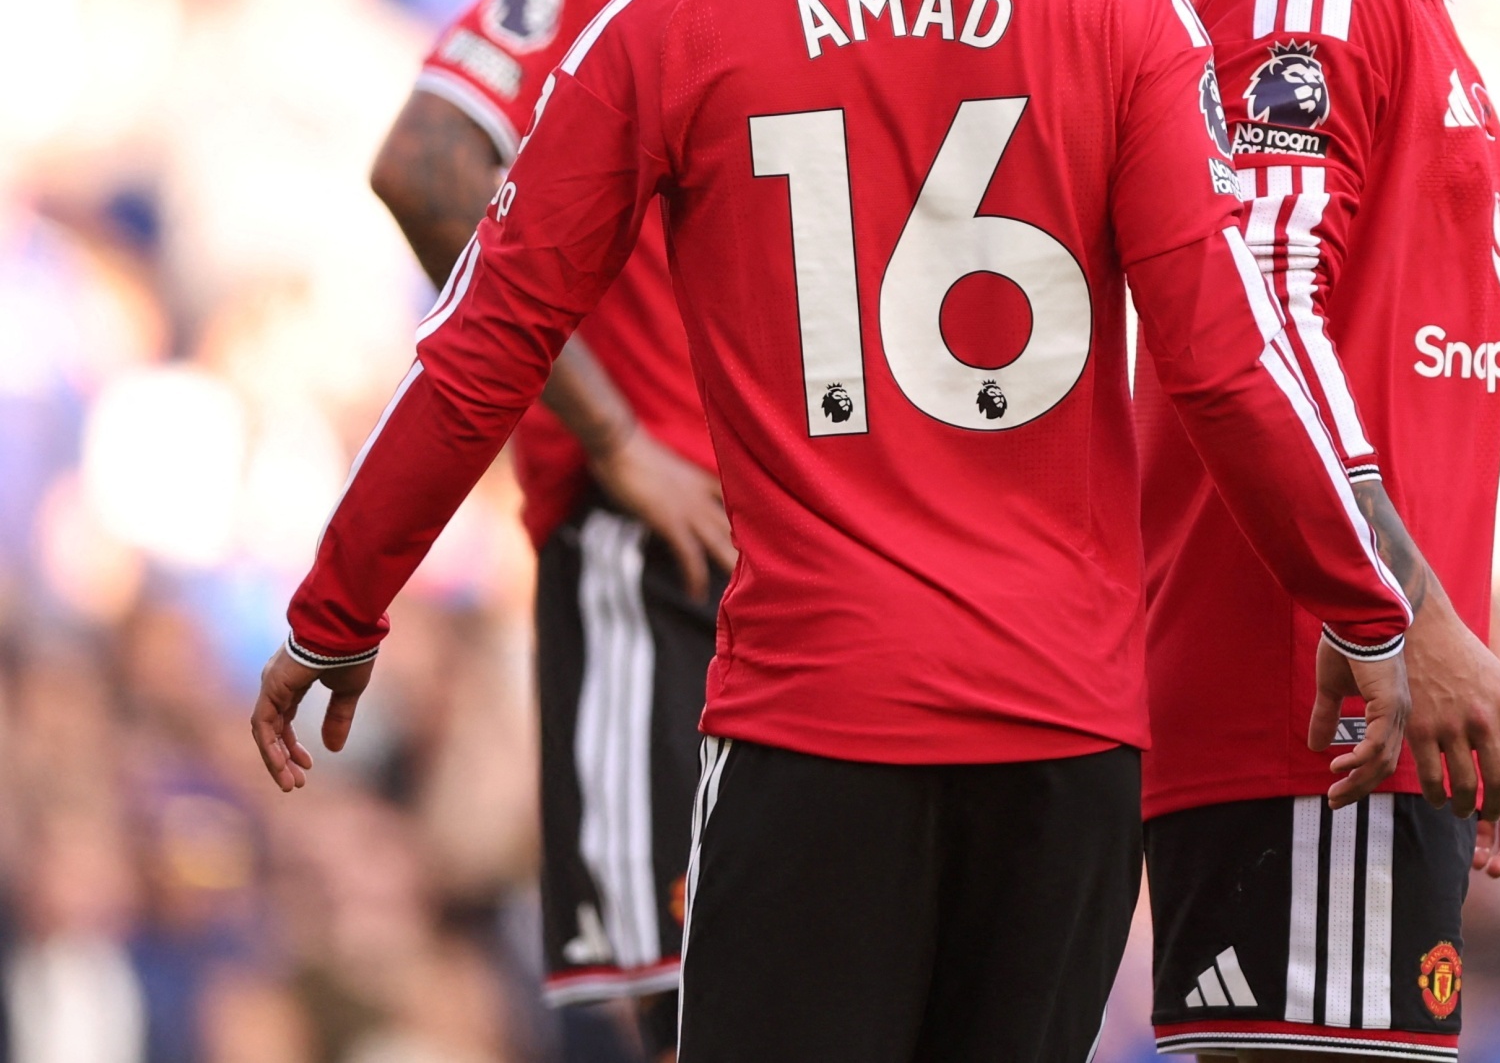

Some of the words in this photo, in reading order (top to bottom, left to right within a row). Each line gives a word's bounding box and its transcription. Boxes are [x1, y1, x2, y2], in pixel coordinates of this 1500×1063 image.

[1234, 122, 1264, 144] No
[1266, 129, 1320, 151] room
[748, 95, 1093, 437] 16
